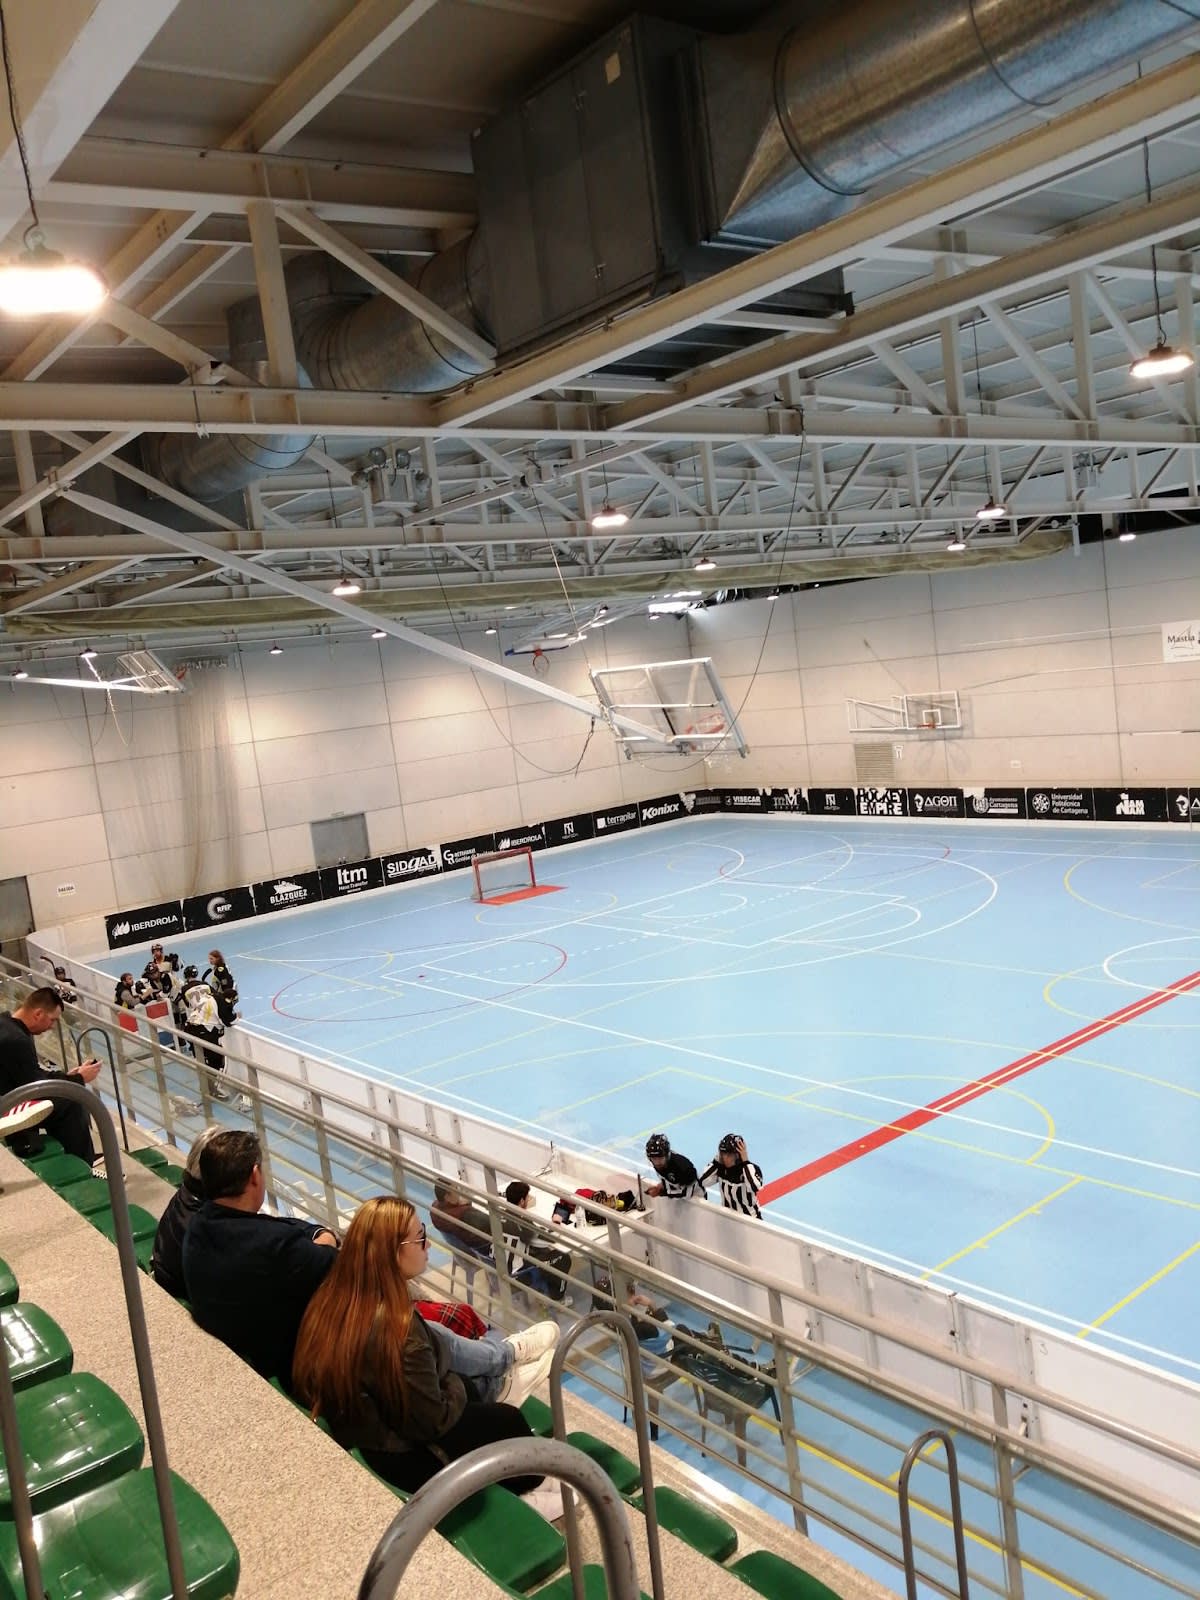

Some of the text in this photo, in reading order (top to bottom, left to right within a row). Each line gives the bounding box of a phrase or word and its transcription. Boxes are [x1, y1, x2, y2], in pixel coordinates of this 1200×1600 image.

[642, 803, 679, 820] Konixx
[1061, 806, 1088, 815] Cartagena
[131, 914, 178, 932] IBERDROLA
